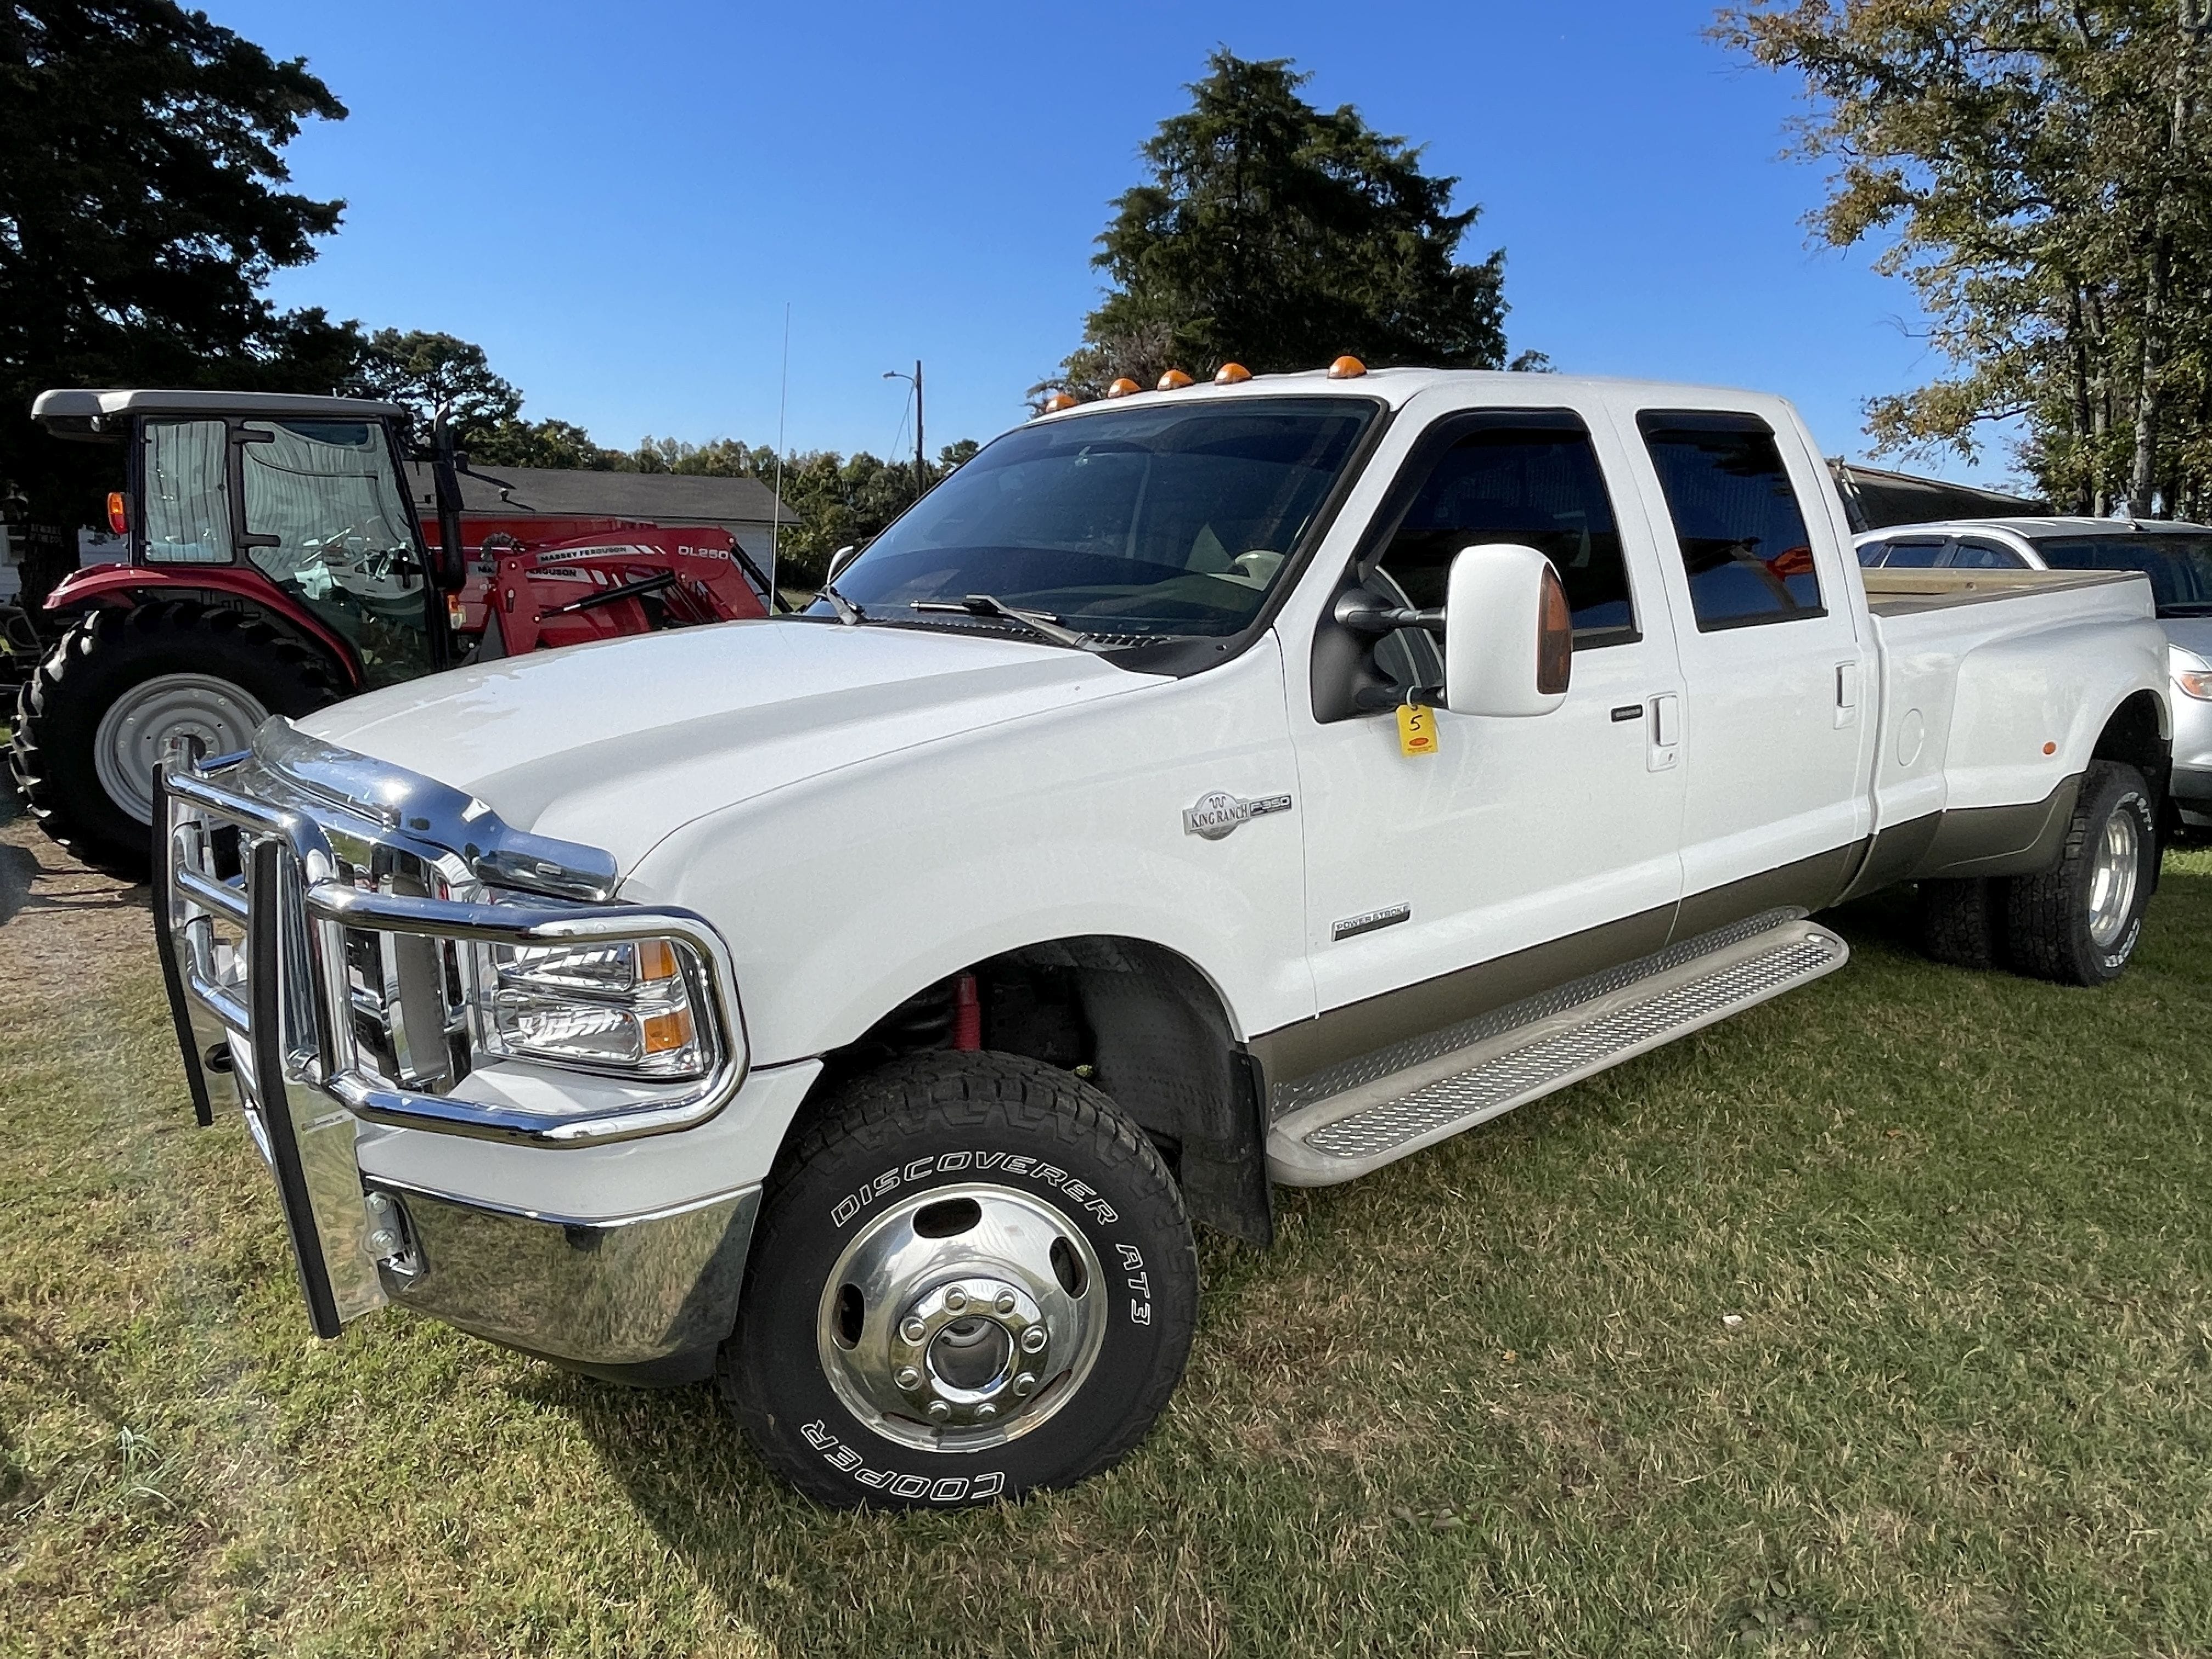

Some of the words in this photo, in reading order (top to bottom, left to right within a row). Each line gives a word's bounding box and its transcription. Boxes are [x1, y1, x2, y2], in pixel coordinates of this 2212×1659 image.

[540, 552, 577, 561] MASSEY
[579, 548, 627, 556] FERGUSON
[678, 545, 729, 560] DL250
[1409, 714, 1423, 731] 5
[1190, 811, 1215, 828] KING
[1217, 803, 1248, 823] RANCH
[1336, 916, 1372, 930] POWER
[830, 1151, 1119, 1228] DISCOVERER
[1115, 1243, 1150, 1325] AT3
[800, 1419, 1005, 1500] COOPER
